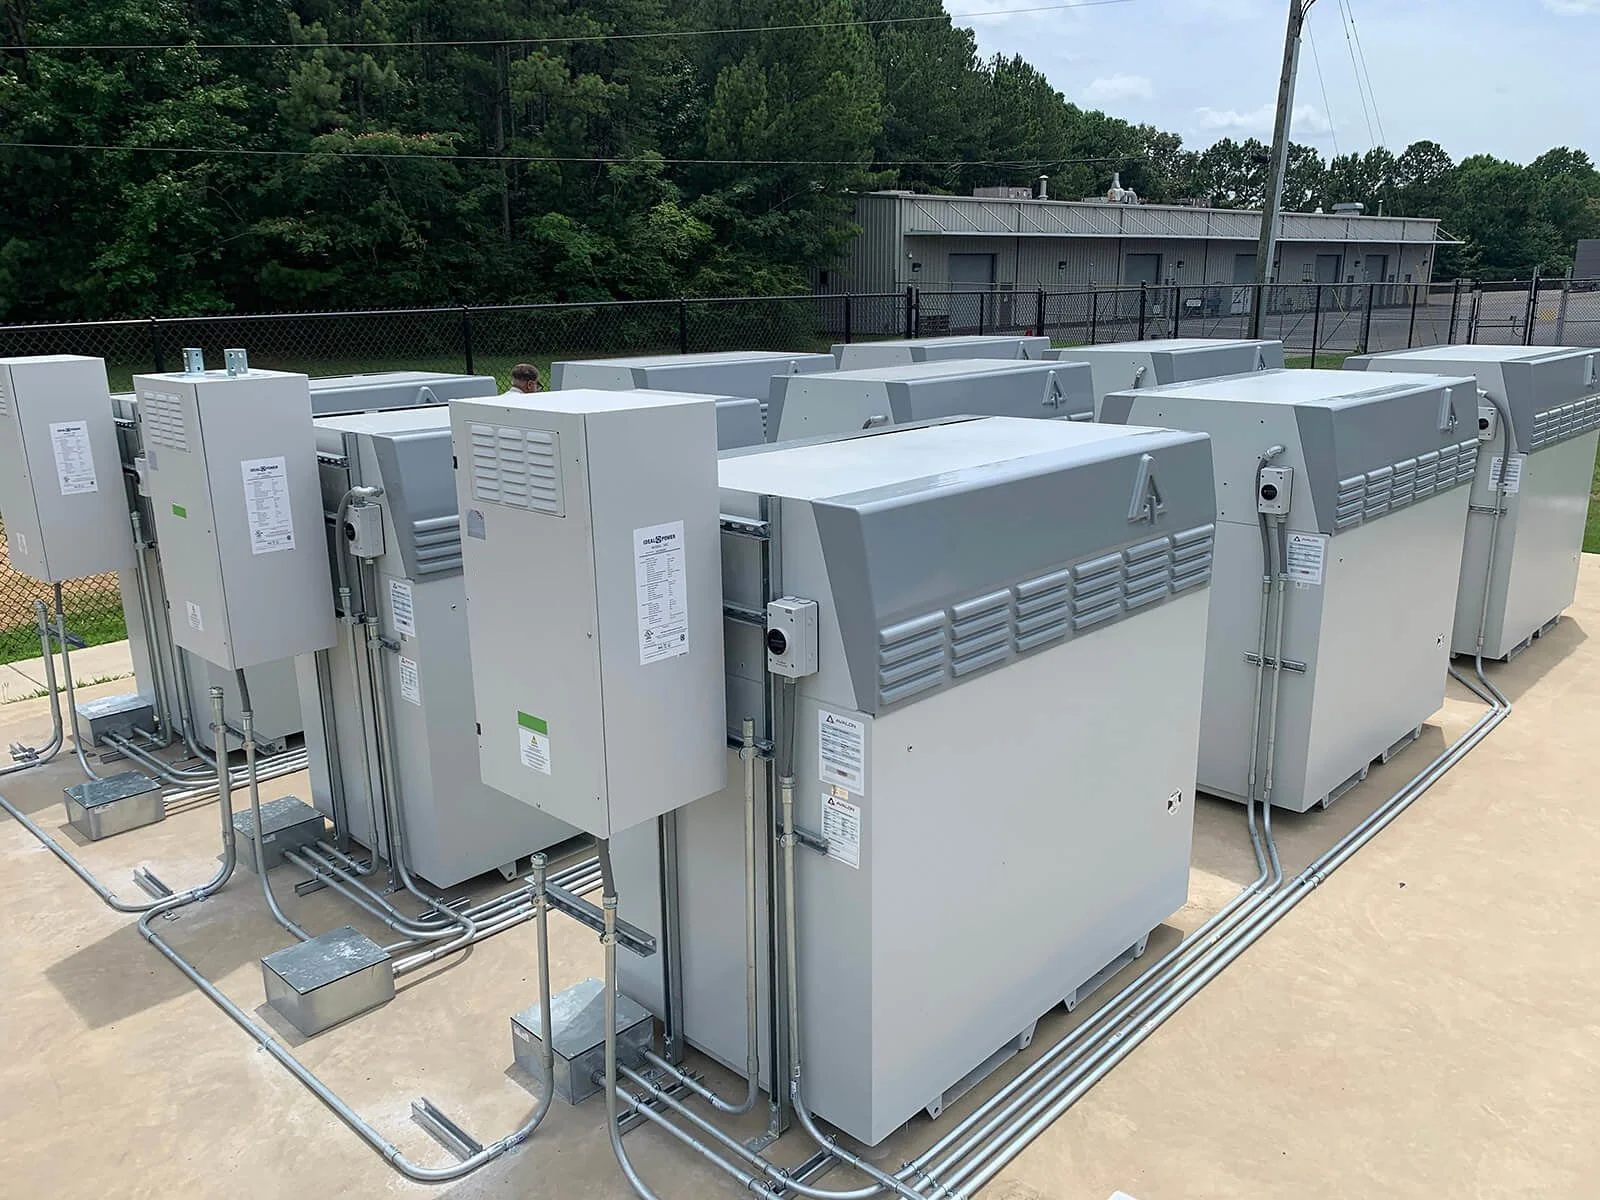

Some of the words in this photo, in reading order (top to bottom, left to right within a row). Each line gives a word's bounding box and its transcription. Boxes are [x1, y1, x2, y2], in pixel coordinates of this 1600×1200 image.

[642, 537, 656, 545] IDEAL
[835, 718, 857, 729] AVALON
[836, 801, 855, 812] AVALON
